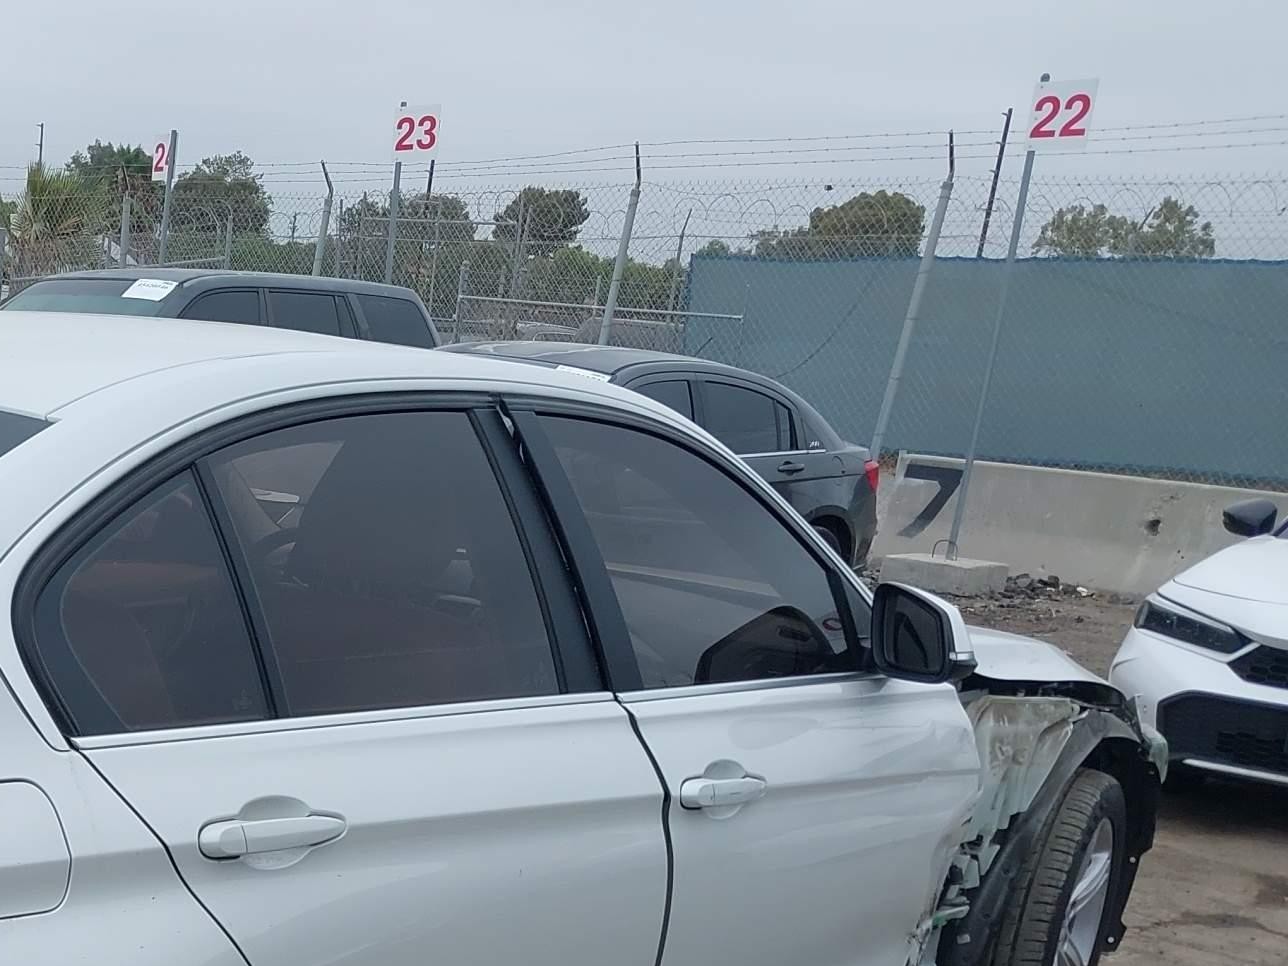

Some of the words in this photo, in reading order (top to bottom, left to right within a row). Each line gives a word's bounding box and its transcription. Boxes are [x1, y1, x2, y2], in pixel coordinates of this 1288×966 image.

[394, 115, 437, 151] 23
[1029, 93, 1091, 139] 22
[153, 142, 169, 173] 2
[896, 463, 964, 539] 7
